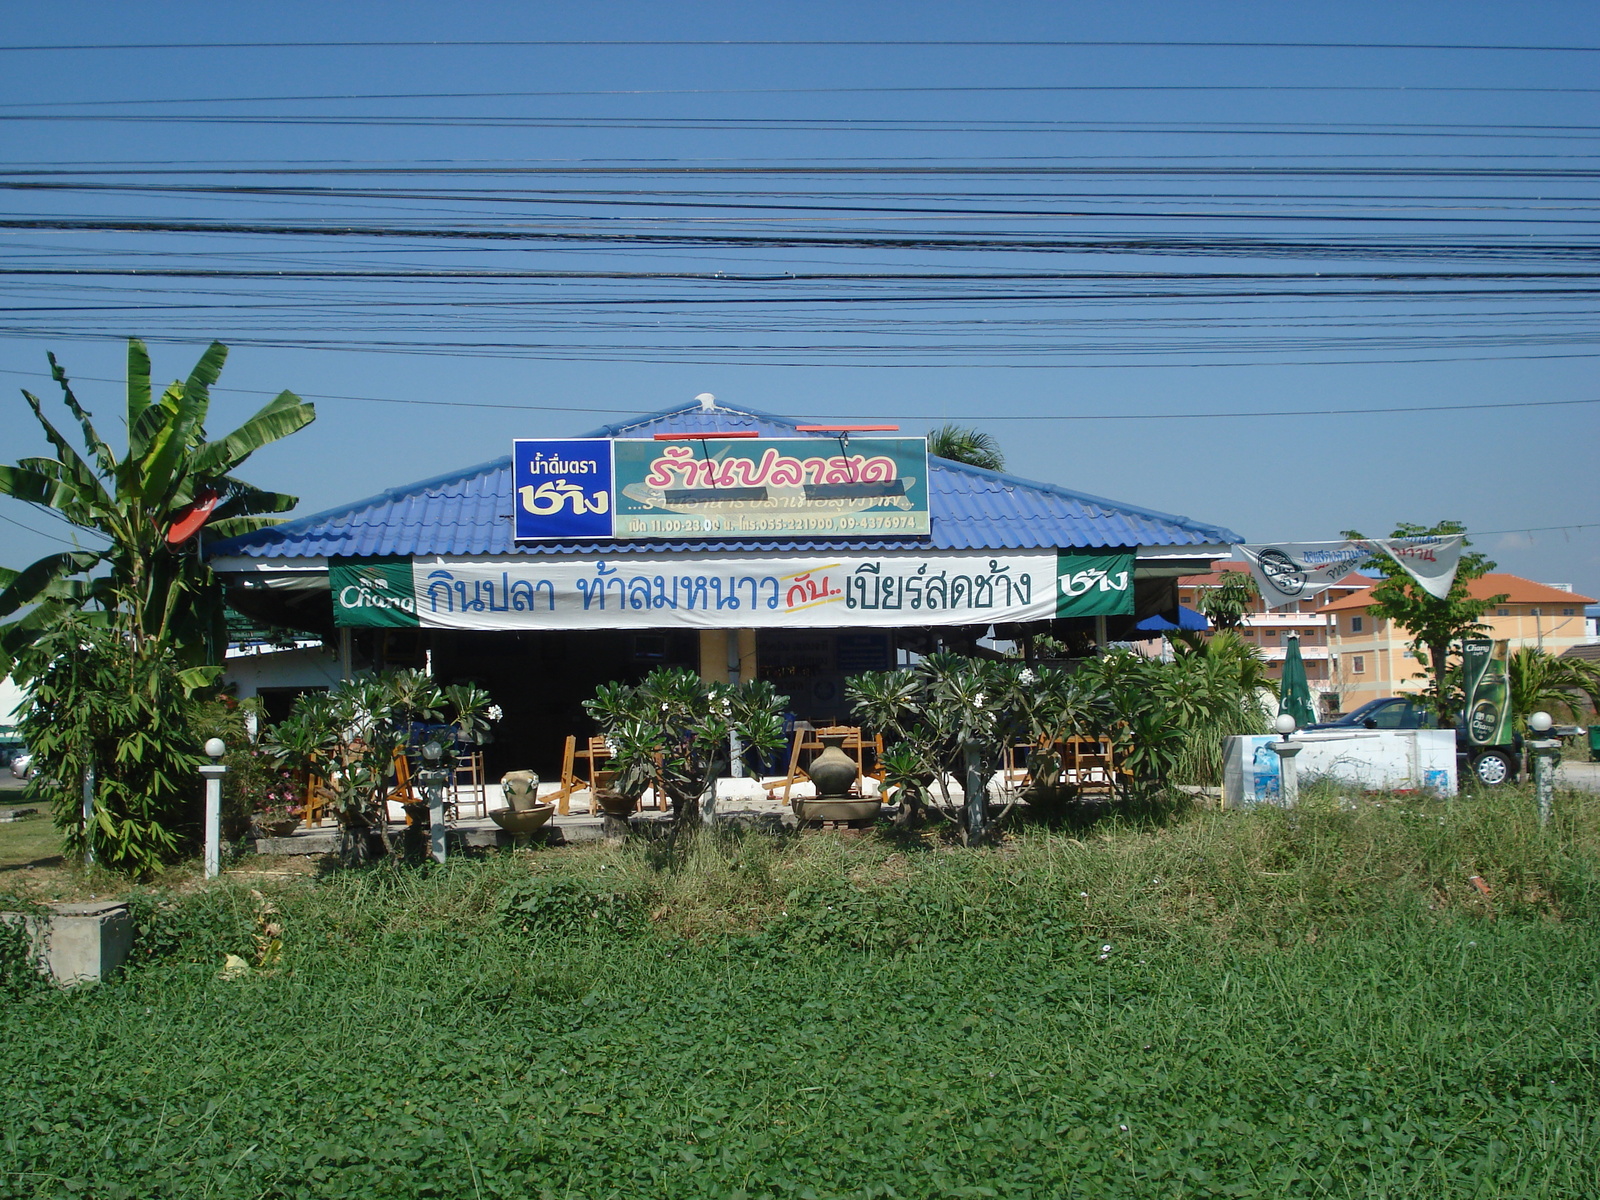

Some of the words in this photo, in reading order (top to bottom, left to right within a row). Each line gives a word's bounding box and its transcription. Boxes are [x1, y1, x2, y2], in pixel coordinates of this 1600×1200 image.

[529, 452, 597, 475] น้ำดื่มตรา
[645, 446, 898, 488] ร้านปลาสด
[518, 479, 609, 516] ช้าง
[427, 569, 555, 613] กินปลา
[576, 560, 780, 611] ท้าลมหนาว
[846, 559, 1032, 611] เบียร์สดช้าง
[1058, 567, 1129, 598] ช้าง
[339, 584, 415, 614] Chang
[1466, 644, 1490, 653] Chang
[1472, 720, 1494, 733] Chang
